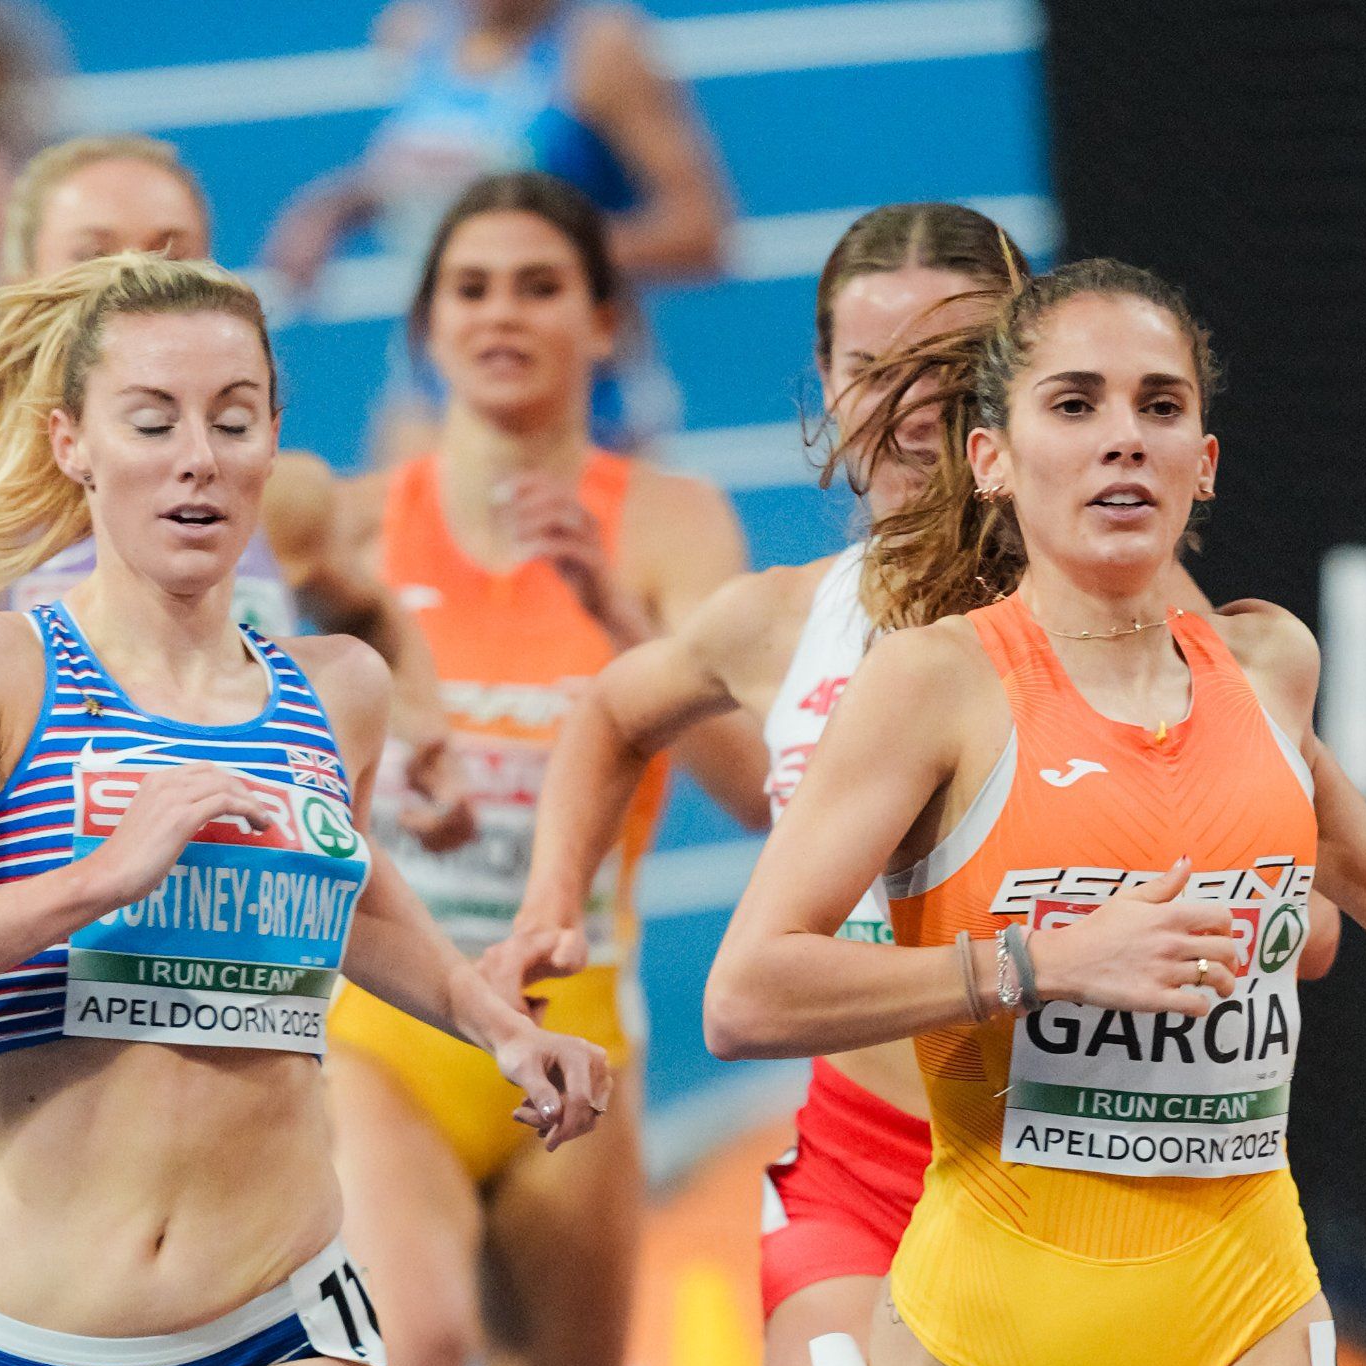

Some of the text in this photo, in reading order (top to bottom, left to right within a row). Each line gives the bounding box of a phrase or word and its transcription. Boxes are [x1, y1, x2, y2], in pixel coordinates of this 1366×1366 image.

[138, 960, 145, 981] I
[153, 961, 213, 987] RUN
[78, 995, 321, 1038] APELDOORN 2025
[1026, 977, 1289, 1064] GARCÍA
[1077, 1090, 1085, 1113] I
[1092, 1091, 1158, 1119] RUN
[1015, 1124, 1281, 1165] APELDOORN 2025
